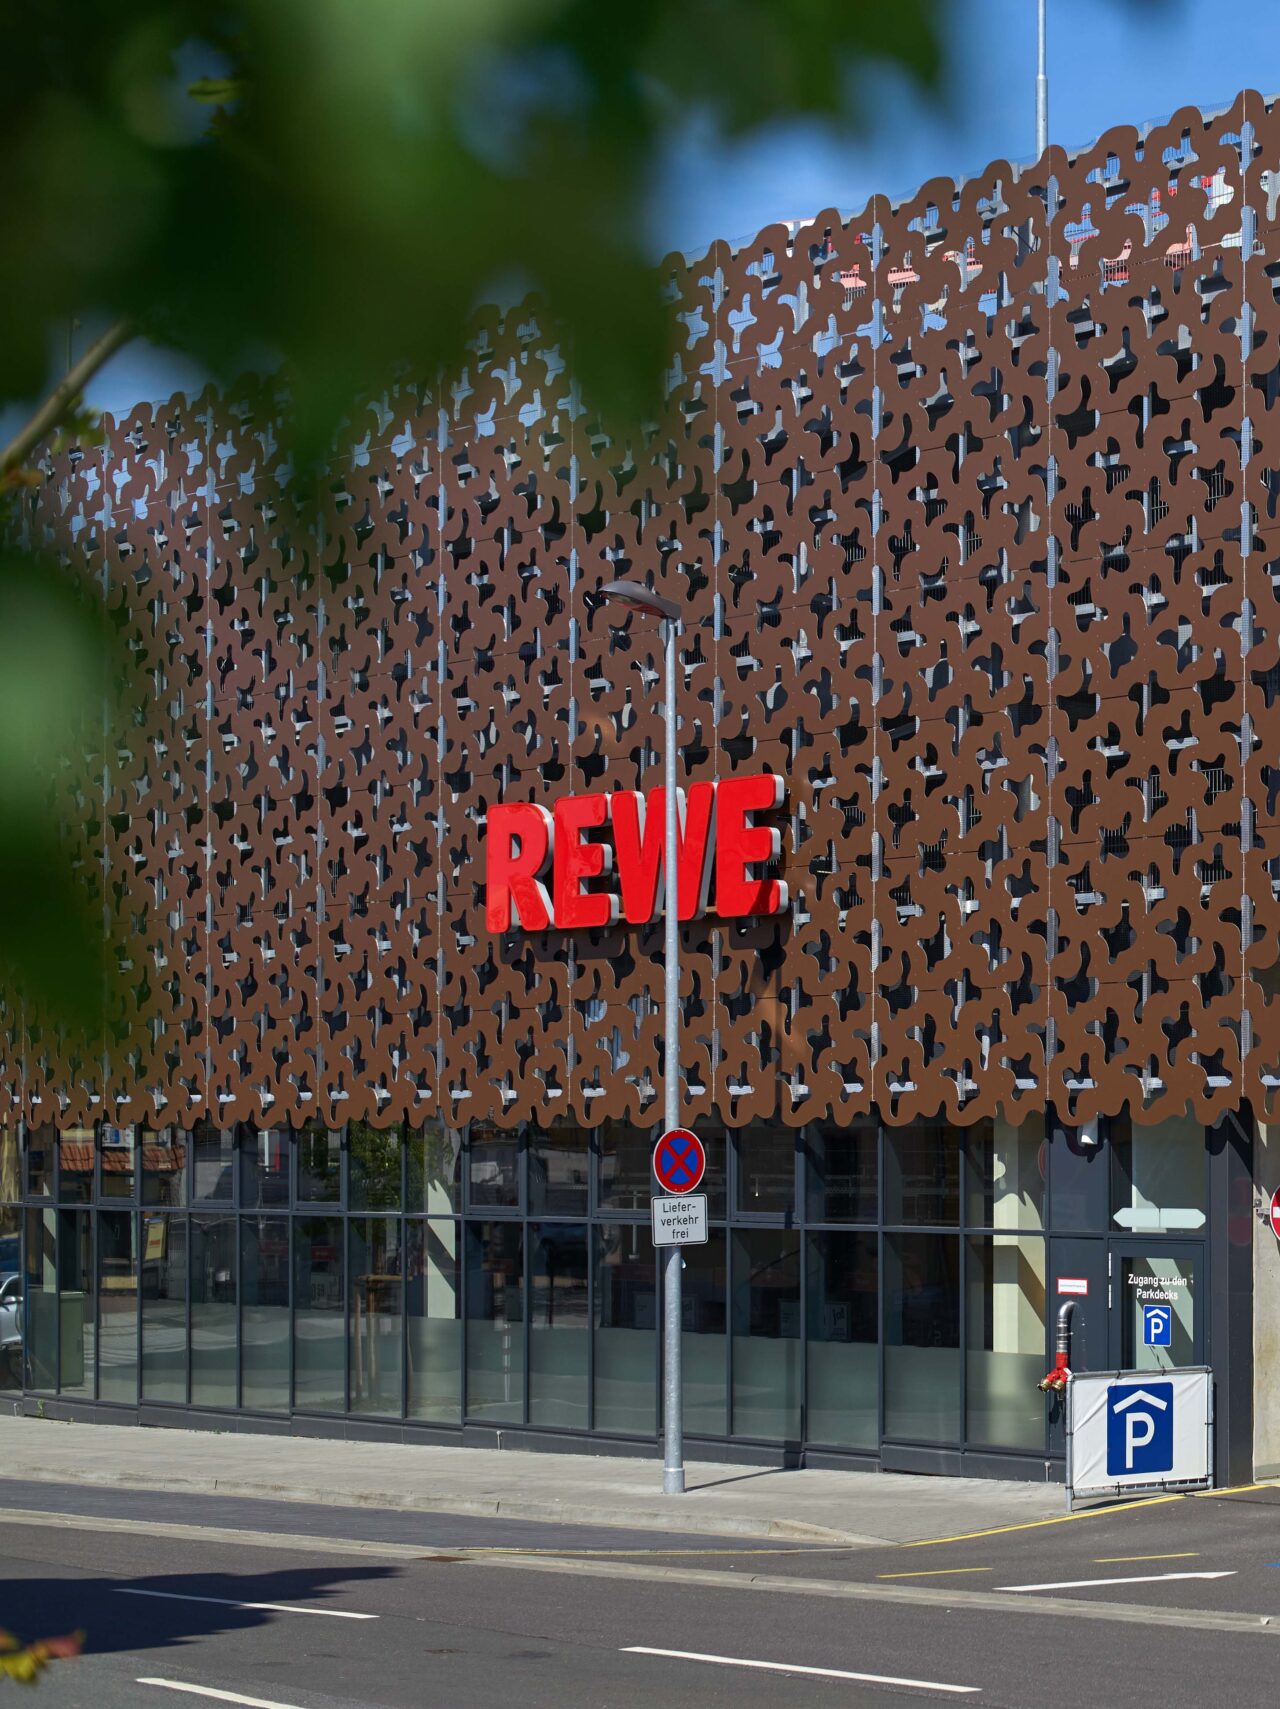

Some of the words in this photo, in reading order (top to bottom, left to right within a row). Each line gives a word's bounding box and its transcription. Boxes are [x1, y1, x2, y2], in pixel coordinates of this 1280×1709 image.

[486, 774, 788, 933] REWE
[663, 1202, 697, 1213] Liefer-
[660, 1214, 699, 1227] verkehr
[672, 1228, 689, 1239] frei
[1128, 1274, 1159, 1287] Zugang
[1159, 1277, 1170, 1285] zu
[1173, 1275, 1187, 1286] den
[1136, 1288, 1179, 1300] Parkdecks
[1151, 1318, 1163, 1342] P
[1125, 1411, 1155, 1469] P
